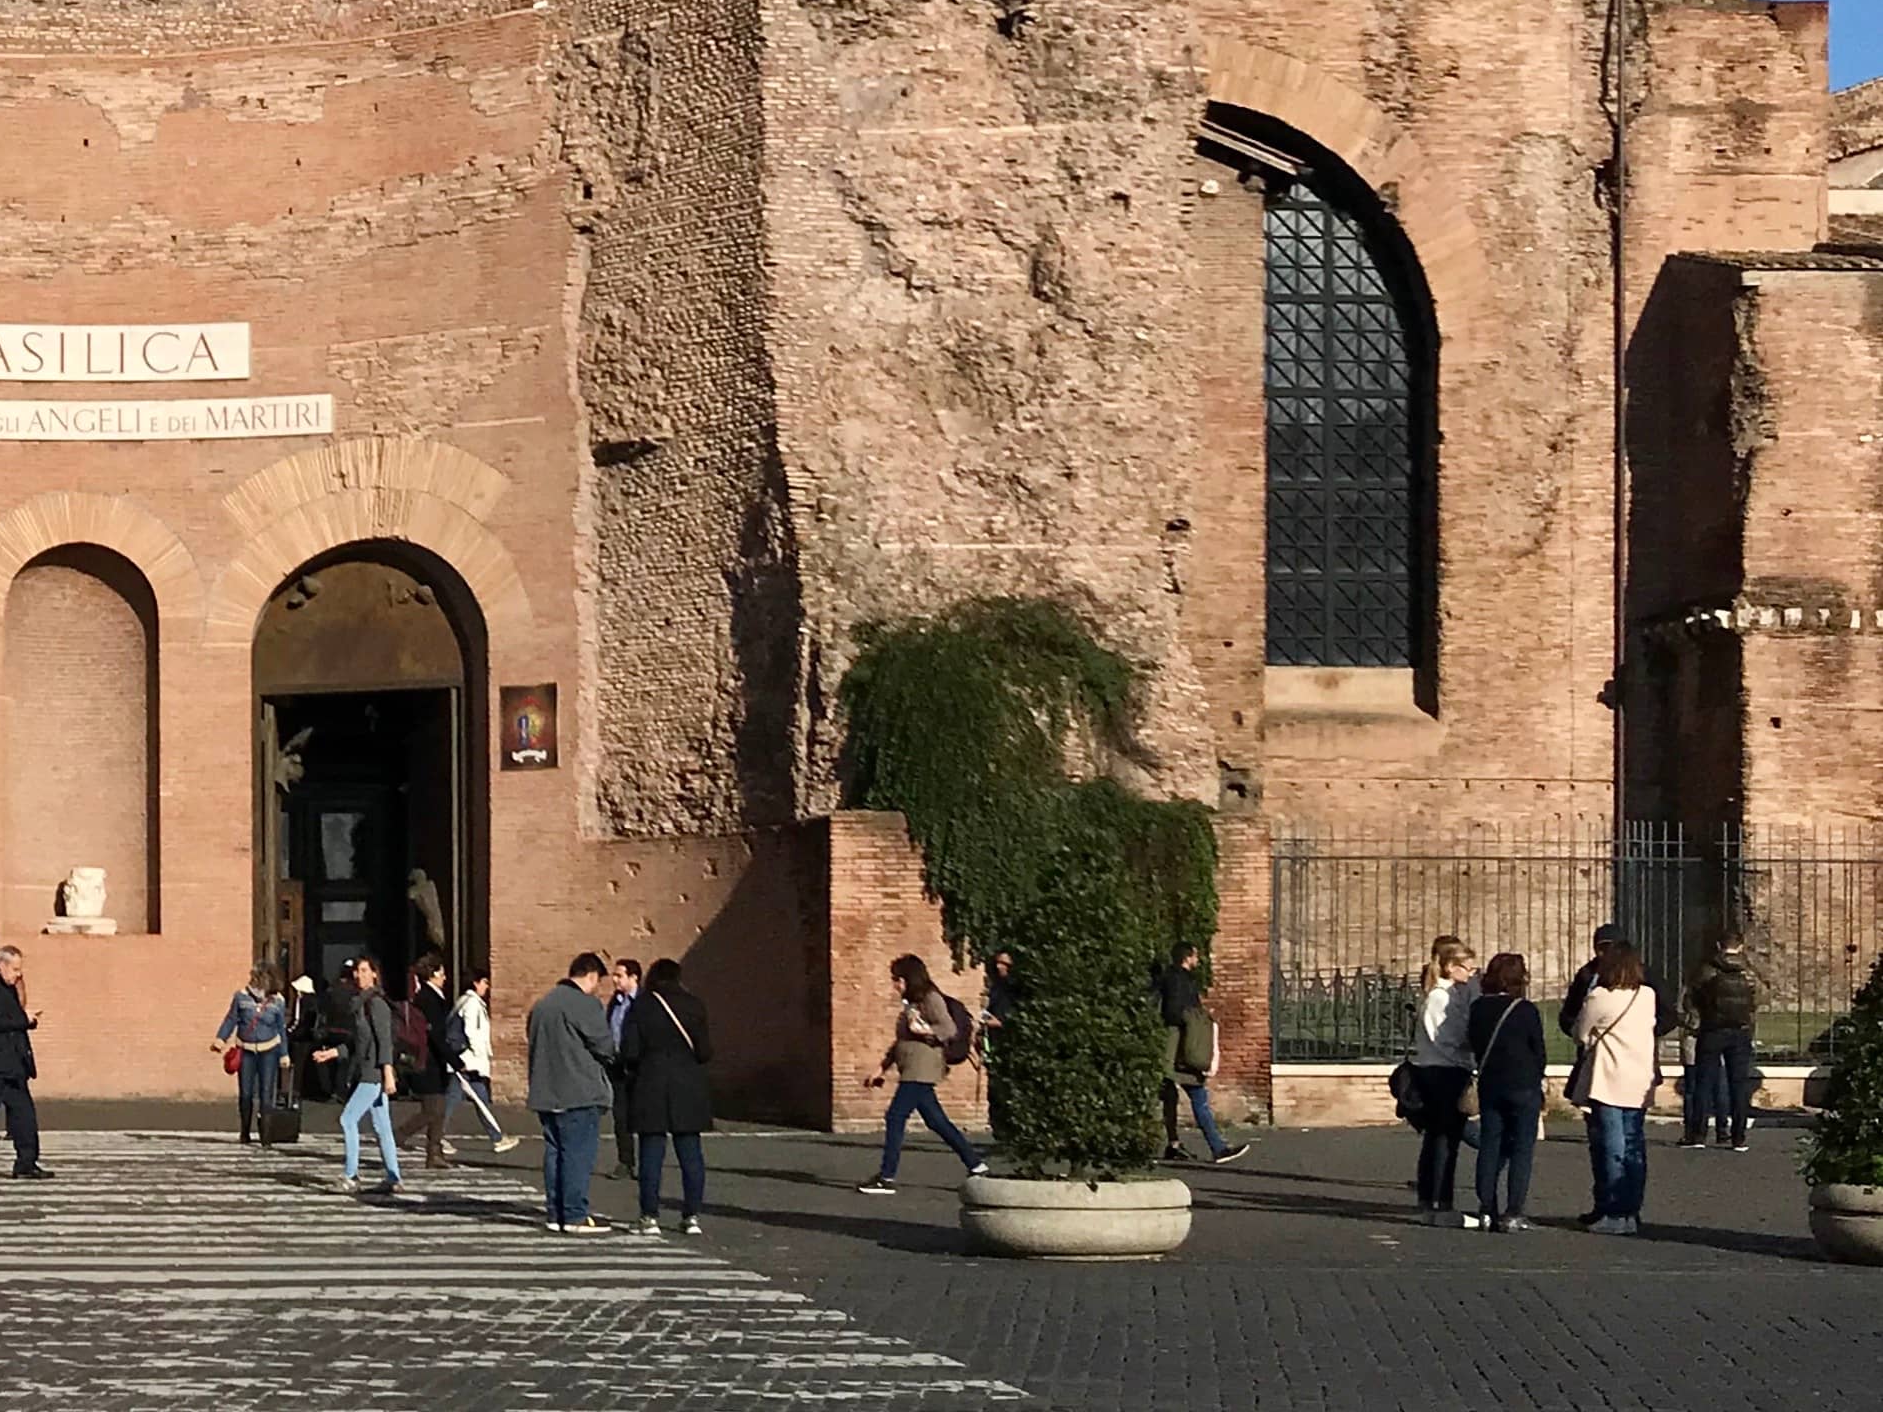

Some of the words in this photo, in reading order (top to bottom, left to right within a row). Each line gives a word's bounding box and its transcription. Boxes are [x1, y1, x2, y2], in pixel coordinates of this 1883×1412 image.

[26, 407, 142, 434] ANGELI
[149, 415, 159, 434] E
[167, 415, 197, 434] DEI
[205, 400, 321, 434] MARTIRI
